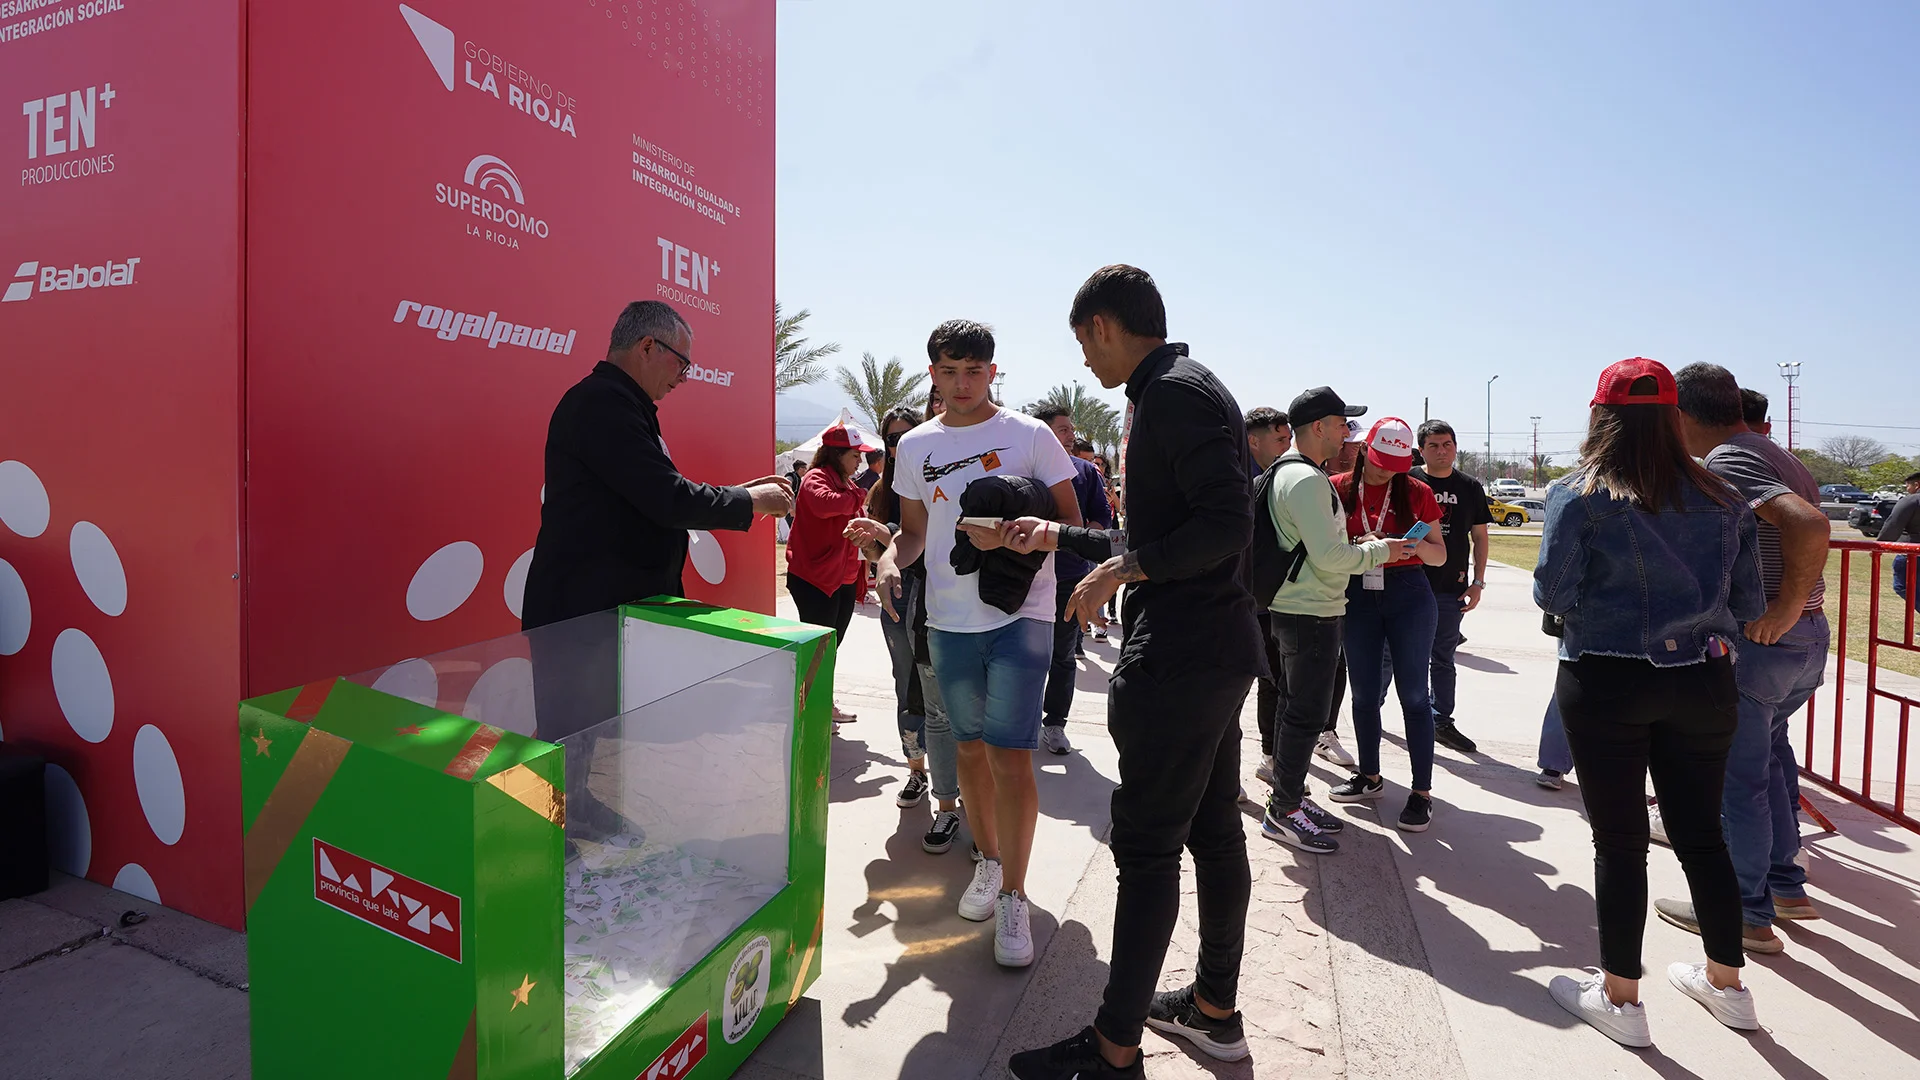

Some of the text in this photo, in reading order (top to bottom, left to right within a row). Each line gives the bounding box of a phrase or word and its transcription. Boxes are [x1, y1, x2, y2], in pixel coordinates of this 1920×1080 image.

[0, 0, 125, 43] NTEGRACIÓN SOCIAL
[464, 40, 577, 115] GOBIERNO DE
[465, 60, 577, 139] LA RIOJA
[23, 82, 116, 160] TEN+
[21, 153, 115, 187] PRODUCCIONES
[632, 133, 696, 178] MINISTERIO DE
[435, 182, 550, 239] SUPERDOMO
[632, 151, 741, 219] DESARROLLO IGUALDAD E
[632, 168, 727, 226] INTEGRACIÓN SOCIAL
[466, 223, 520, 250] LA RIOJA
[657, 236, 721, 296] TEN+
[393, 299, 577, 356] royalpadel
[656, 283, 721, 316] PRODUCCIONES
[1434, 491, 1458, 505] ola
[320, 880, 400, 921] provincia que late
